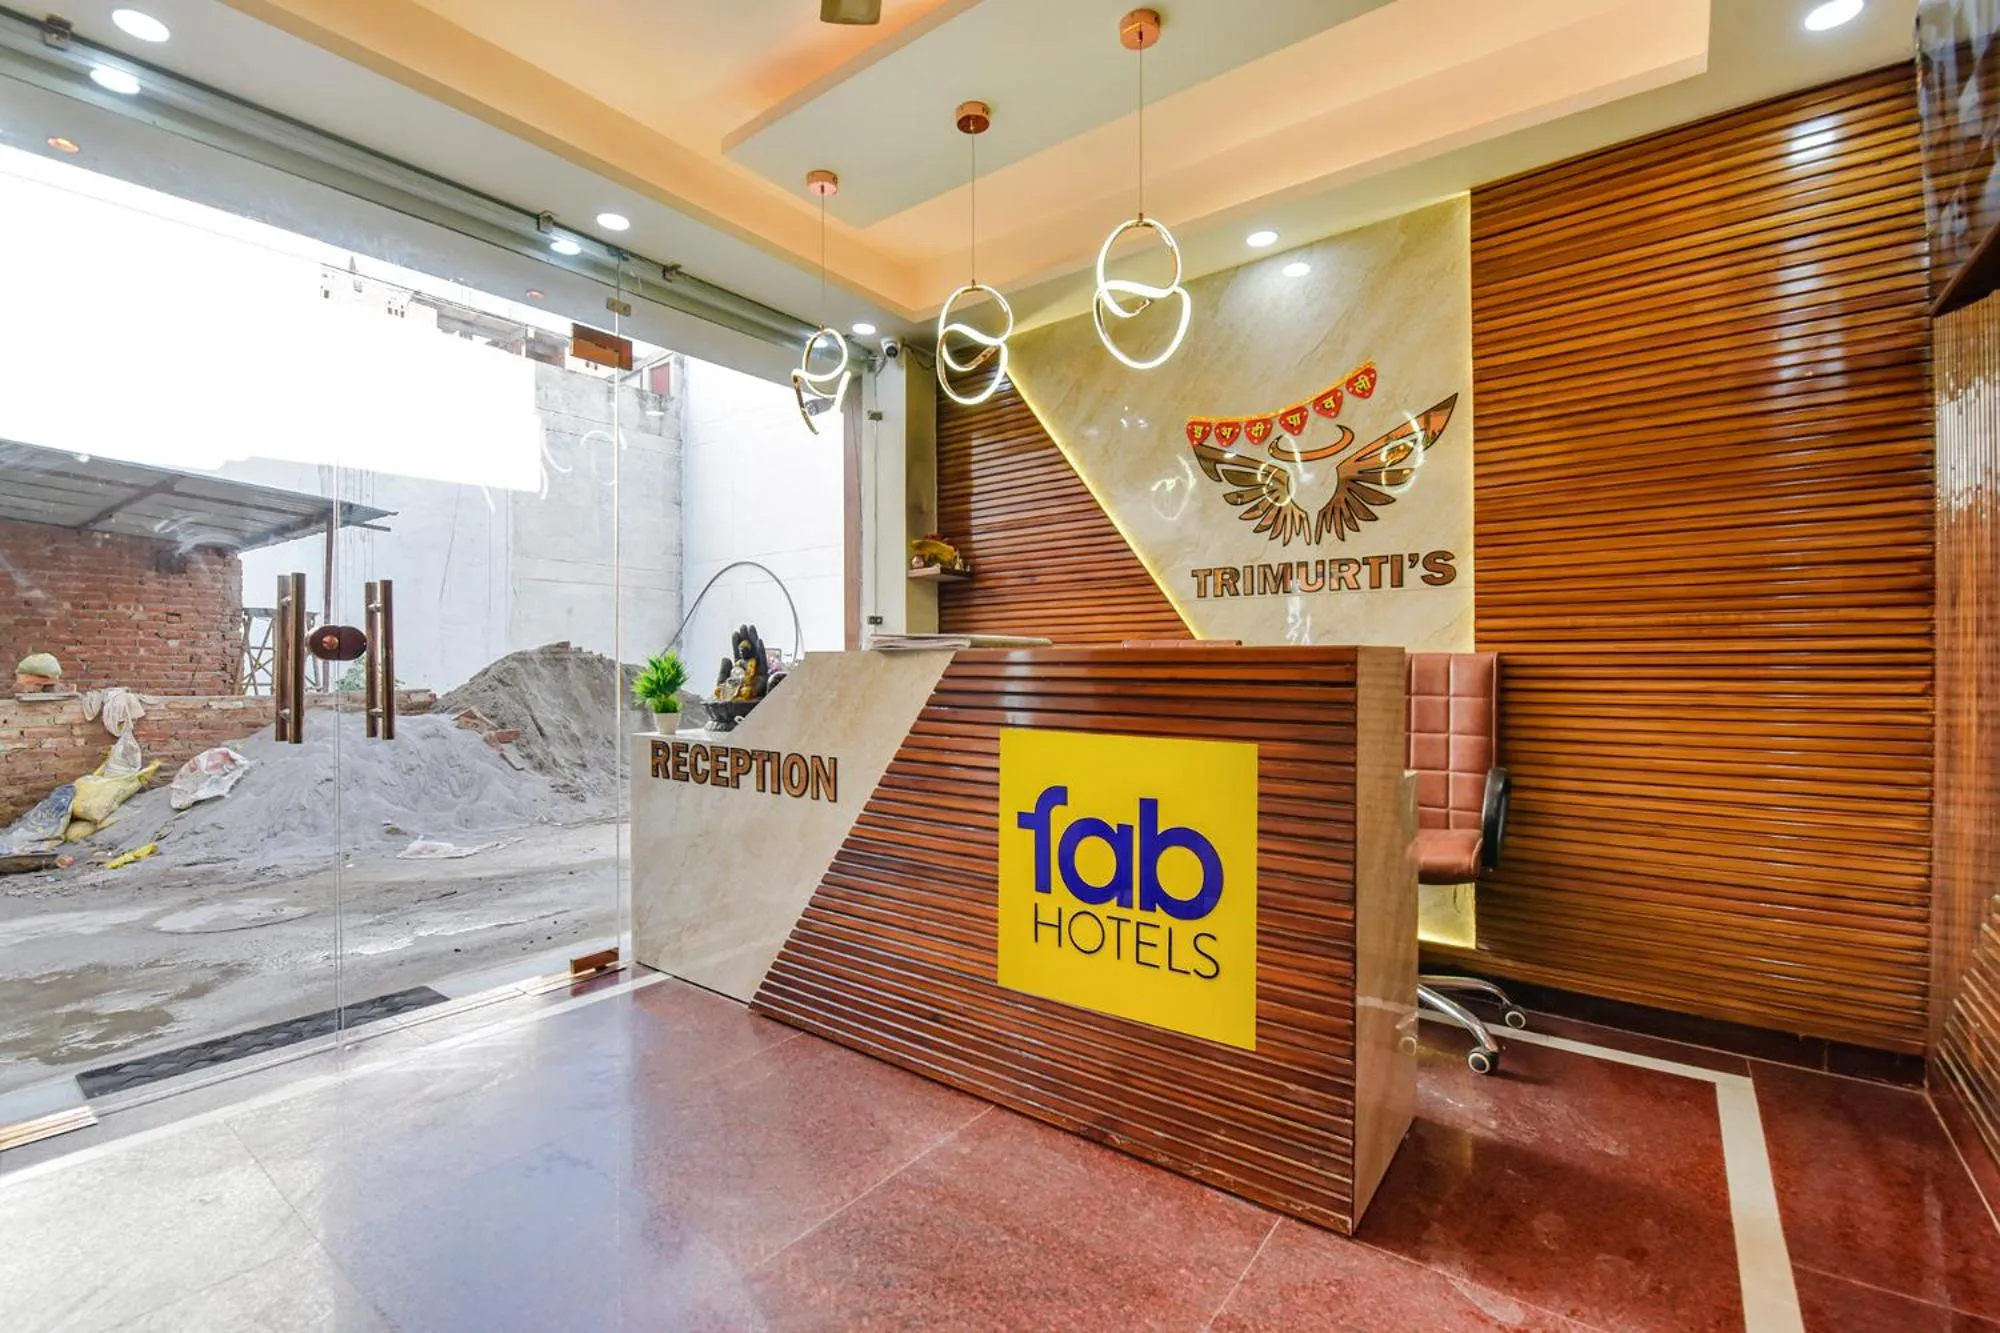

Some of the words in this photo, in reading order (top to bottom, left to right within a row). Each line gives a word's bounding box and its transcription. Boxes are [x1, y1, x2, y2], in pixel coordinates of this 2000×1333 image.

[1191, 550, 1457, 598] TRIMURTI'S
[650, 739, 838, 803] RECEPTION
[1017, 785, 1224, 921] fab
[1034, 902, 1222, 980] HOTELS
